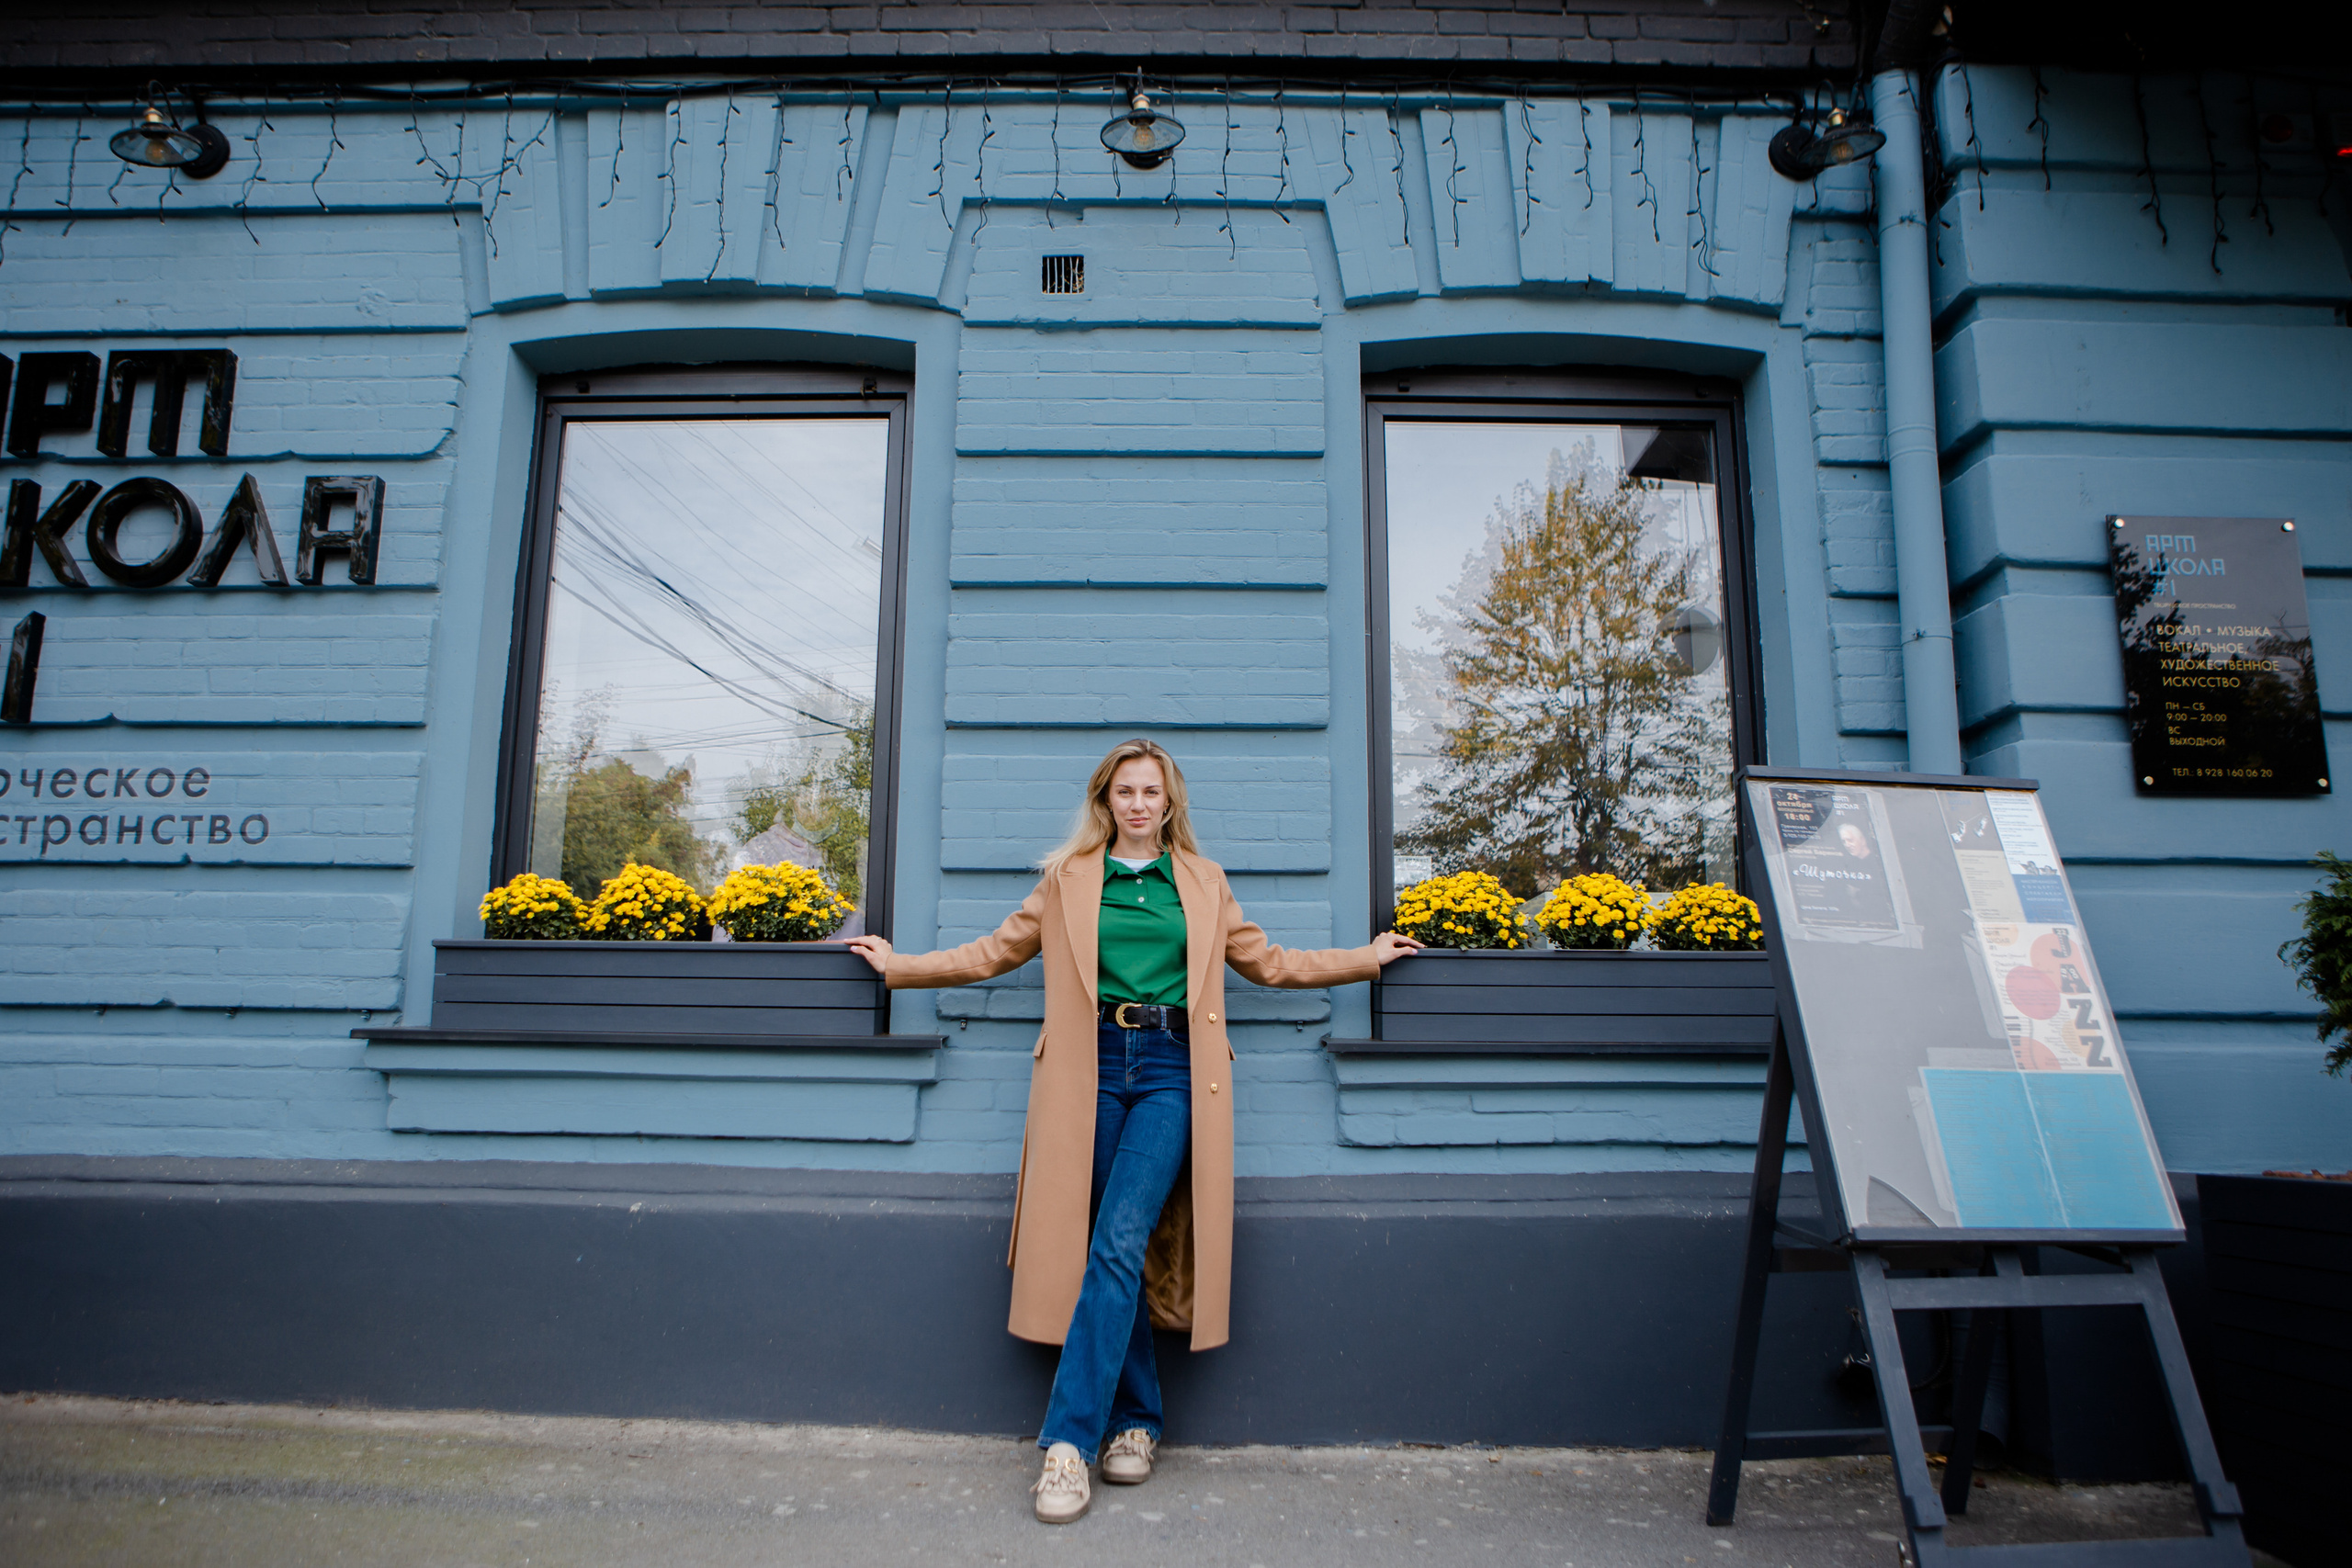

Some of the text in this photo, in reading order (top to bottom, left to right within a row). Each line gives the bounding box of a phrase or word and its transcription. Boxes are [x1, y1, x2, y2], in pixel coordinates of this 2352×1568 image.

[2145, 535, 2197, 553] АРТ
[2148, 558, 2226, 577] ШКОЛА
[2152, 579, 2177, 597] #1
[2156, 625, 2272, 637] ВОКАЛ МУЗЫКА
[2158, 641, 2248, 655] ТЕАТРАЛЬНОЕ,
[2161, 659, 2280, 671] ХУДОЖЕСТВЕННОЕ
[2162, 676, 2241, 688] ИСКУССТВО
[2165, 702, 2180, 710] ПН
[2192, 702, 2206, 711] СБ
[2166, 713, 2188, 722] 9:00
[2200, 713, 2227, 722] 20:00
[2168, 726, 2181, 735] ВС
[2169, 736, 2226, 747] ВЫХОДНОЙ
[2196, 768, 2203, 777] 8
[2205, 768, 2223, 778] 928
[2226, 768, 2244, 778] 160
[2245, 769, 2259, 778] 06
[2260, 769, 2274, 779] 20
[1776, 800, 1813, 809] октября
[1783, 812, 1812, 821] 18:00
